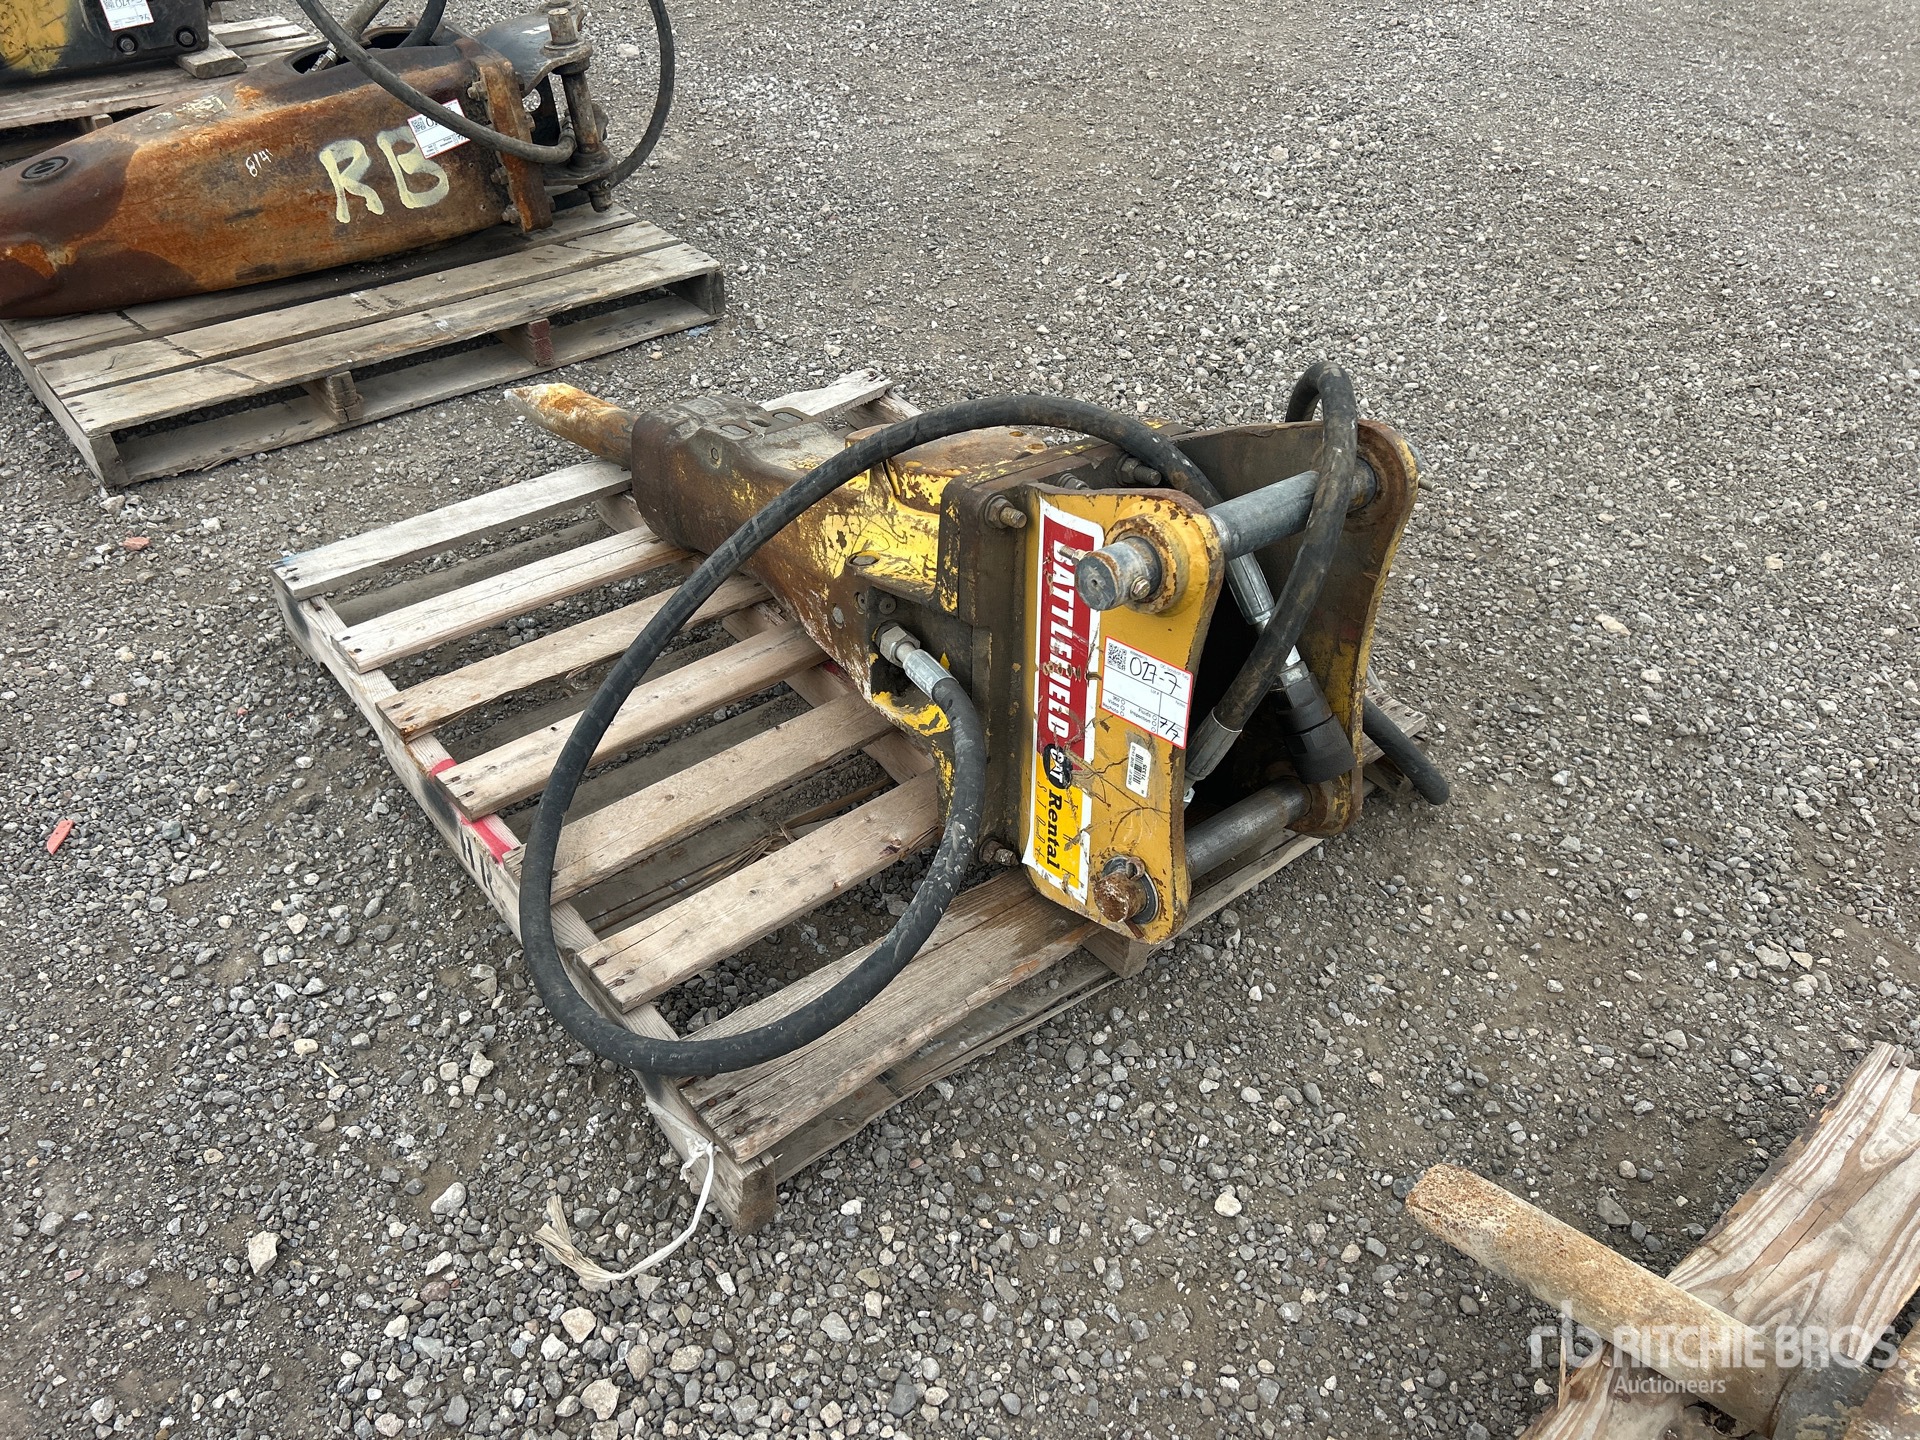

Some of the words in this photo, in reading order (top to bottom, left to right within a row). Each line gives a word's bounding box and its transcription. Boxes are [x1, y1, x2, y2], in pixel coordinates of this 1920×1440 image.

[319, 126, 449, 223] RB
[1048, 539, 1075, 739] BATTLEFIELD
[1047, 788, 1062, 870] Rental
